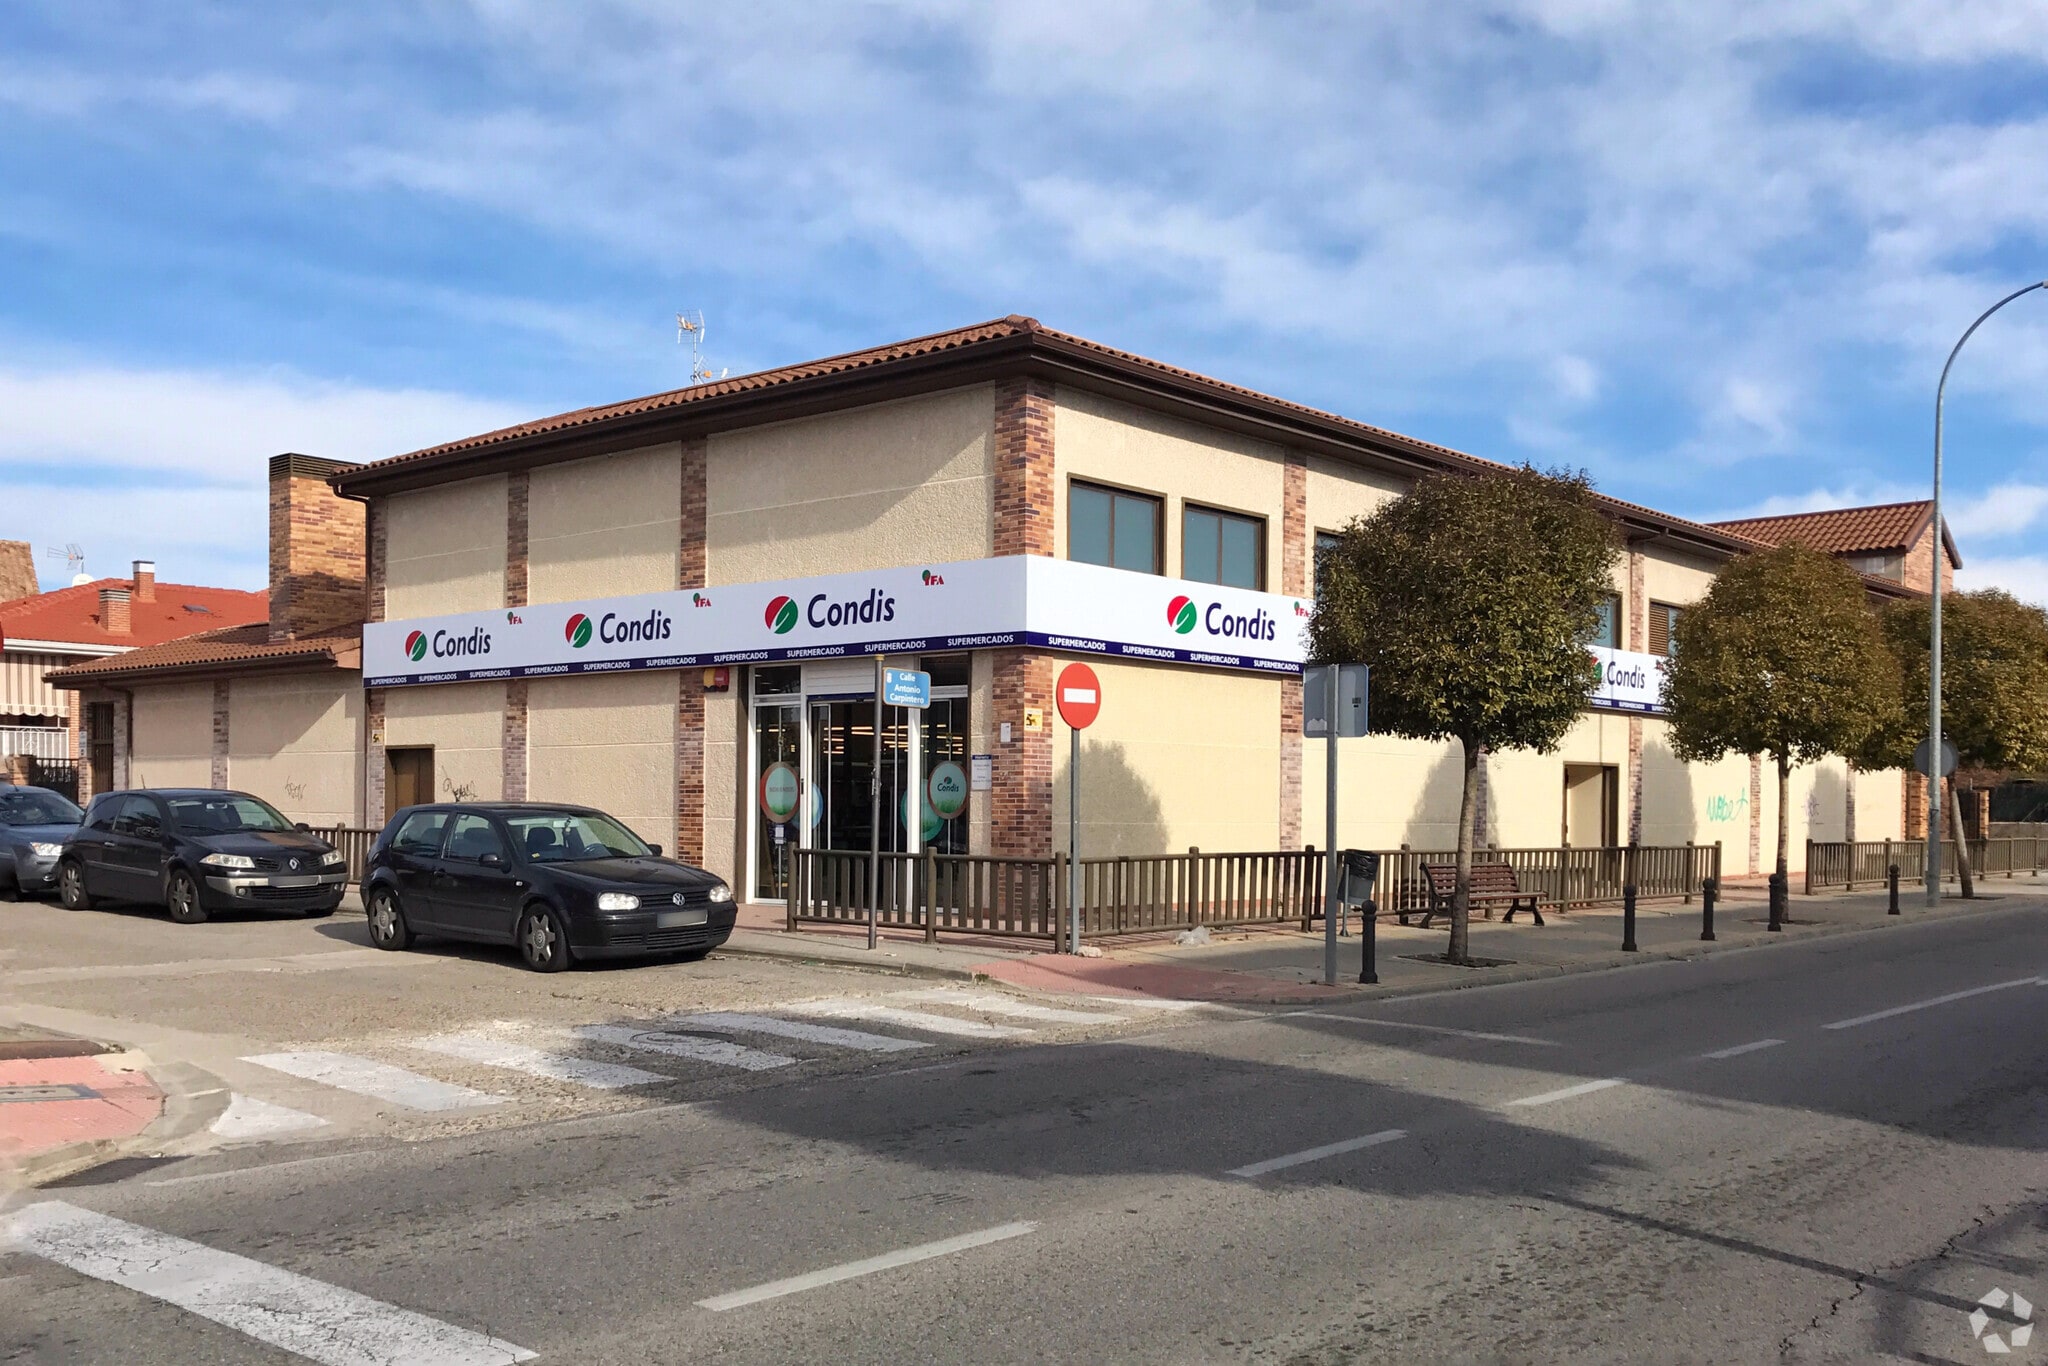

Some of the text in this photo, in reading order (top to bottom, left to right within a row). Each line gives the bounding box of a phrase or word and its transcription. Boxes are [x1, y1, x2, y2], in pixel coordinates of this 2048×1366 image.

[807, 588, 896, 628] Condis
[1205, 602, 1276, 641] Condis
[432, 626, 491, 658] Condis
[600, 609, 671, 644] Condis
[418, 673, 457, 682] SUPERMERCADOS
[469, 669, 511, 678] SUPERMERCADOS
[524, 664, 569, 675] SUPERMERCADOS
[583, 660, 631, 671] SUPERMERCADOS
[646, 656, 697, 667] SUPERMERCADOS
[713, 651, 769, 663] SUPERMERCADOS
[786, 646, 845, 658] SUPERMERCADOS
[864, 640, 926, 652] SUPERMERCADOS
[947, 634, 1014, 647] SUPERMERCADOS
[1048, 636, 1300, 672] SUPERMERCADOS SUPERMERCADOS SUPERMERCADOS SUPERMERCADOS
[894, 683, 921, 694] Antonio
[899, 672, 916, 682] Calle
[1606, 660, 1646, 689] Condis
[889, 692, 925, 704] Carpintero
[936, 782, 959, 792] Condis
